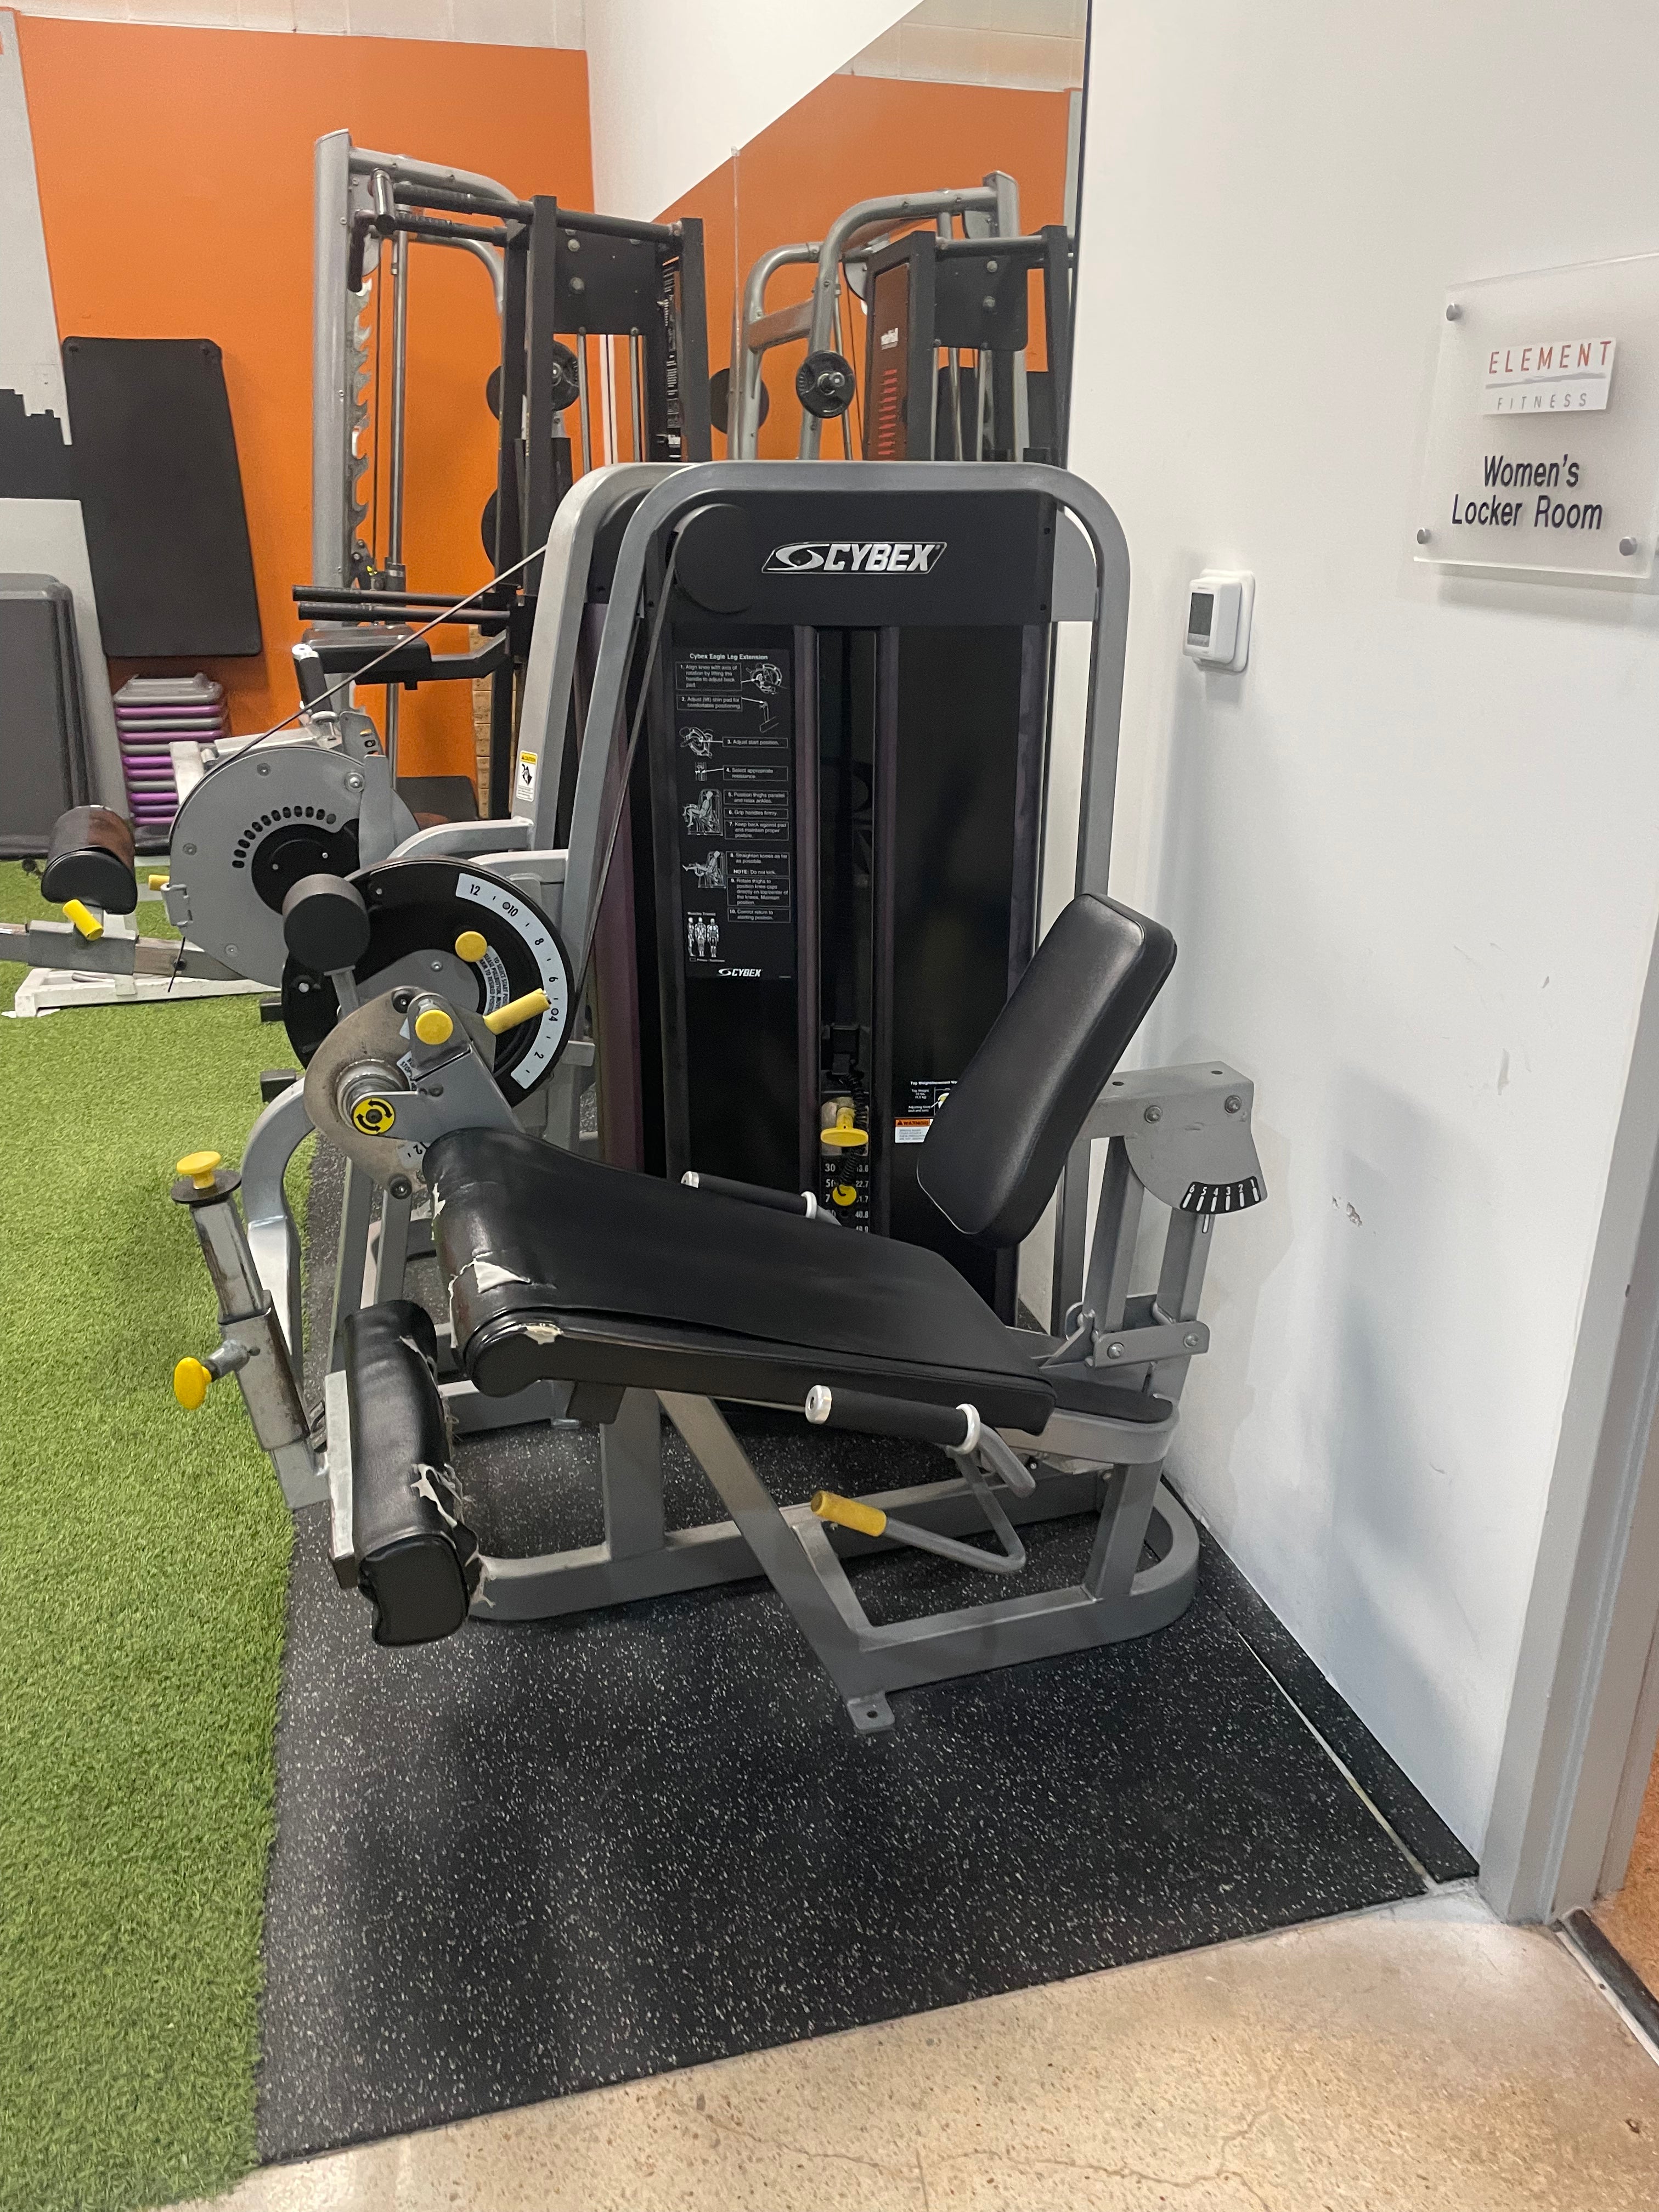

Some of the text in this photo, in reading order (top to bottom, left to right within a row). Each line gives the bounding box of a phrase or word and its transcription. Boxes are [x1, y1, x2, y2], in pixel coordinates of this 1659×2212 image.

[1489, 340, 1612, 374] ELEMENT
[1497, 393, 1587, 410] FITNESS
[1484, 454, 1579, 487] Women's
[1452, 494, 1602, 529] Locker Room
[823, 544, 935, 572] CYBEX
[470, 884, 481, 896] 12
[507, 905, 518, 917] 10
[731, 968, 761, 977] CYBEX
[825, 1163, 836, 1172] 30
[1189, 1184, 1195, 1193] 6
[1200, 1187, 1207, 1195] 5
[1213, 1187, 1218, 1196] 4
[1226, 1186, 1231, 1195] 3
[1238, 1184, 1243, 1193] 2
